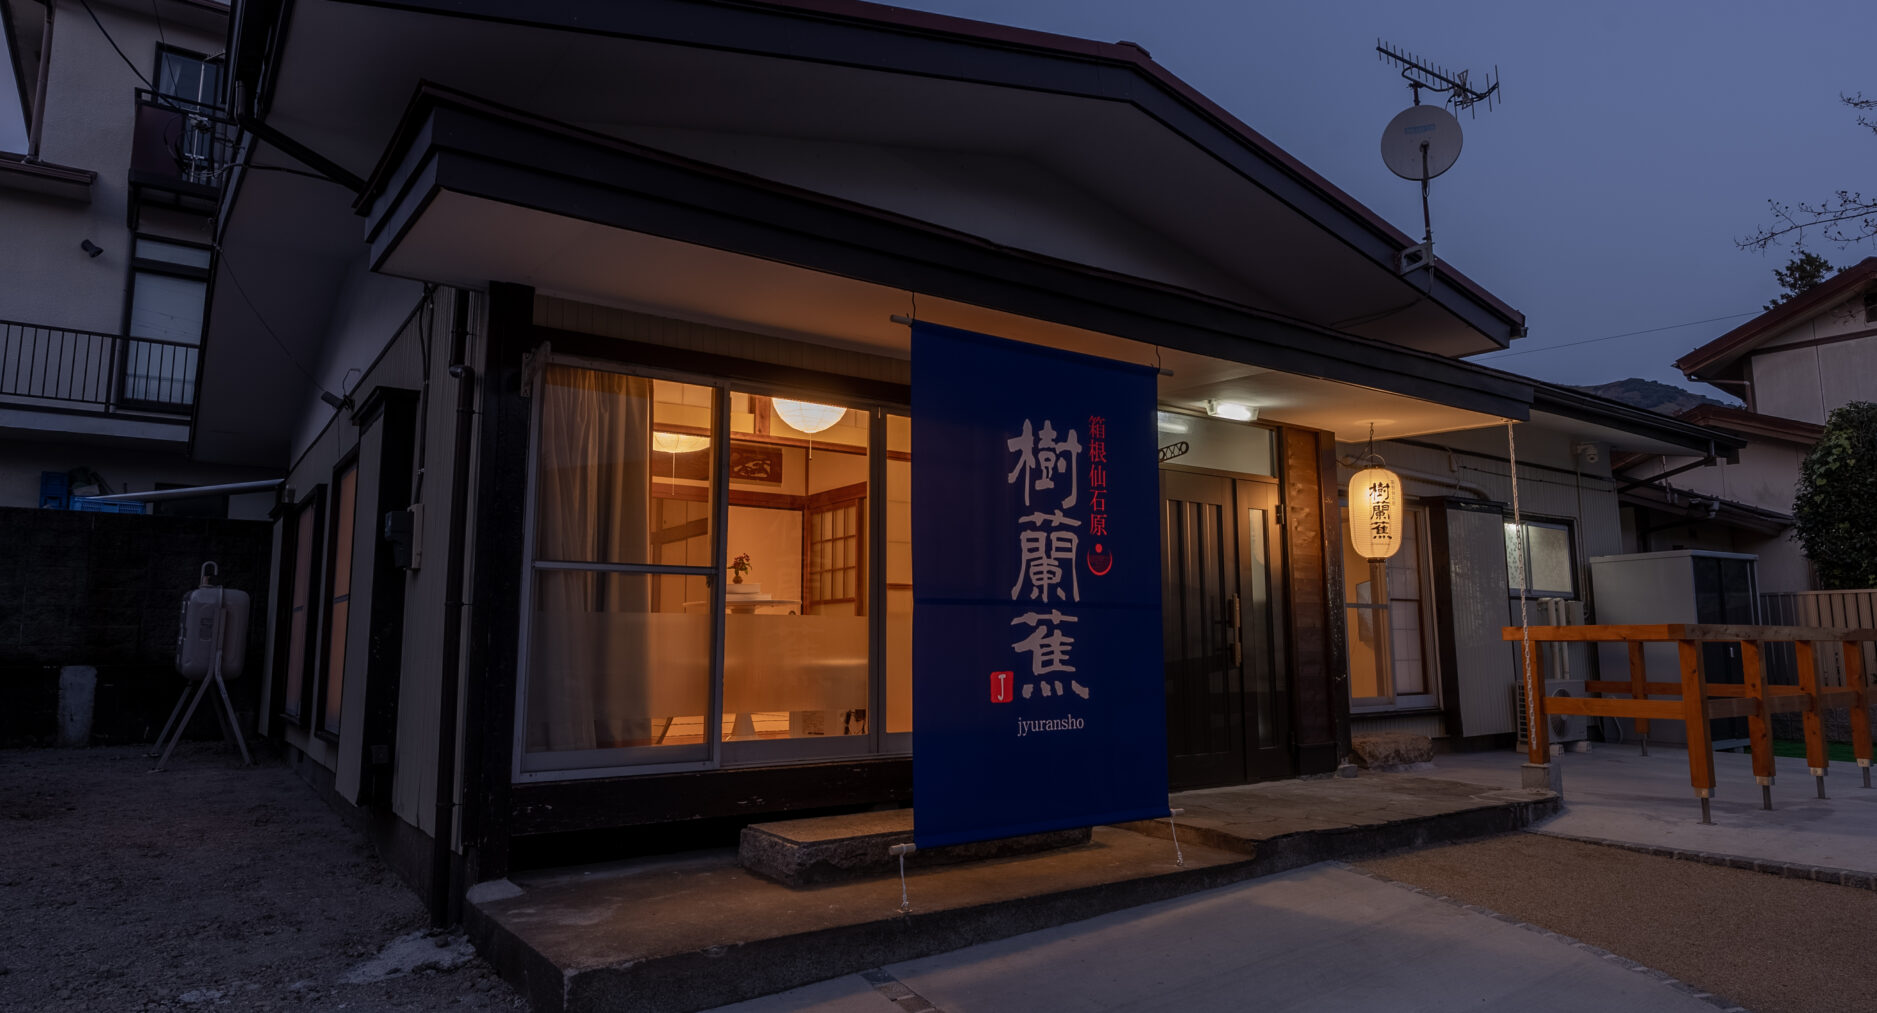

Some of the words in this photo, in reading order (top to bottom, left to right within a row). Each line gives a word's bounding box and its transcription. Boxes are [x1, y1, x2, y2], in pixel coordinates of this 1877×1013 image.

[1089, 416, 1107, 536] 箱根仙石原
[1369, 482, 1392, 540] 樹蘭蕉
[1008, 419, 1090, 699] 樹蘭蕉
[1017, 714, 1085, 737] jyuransho
